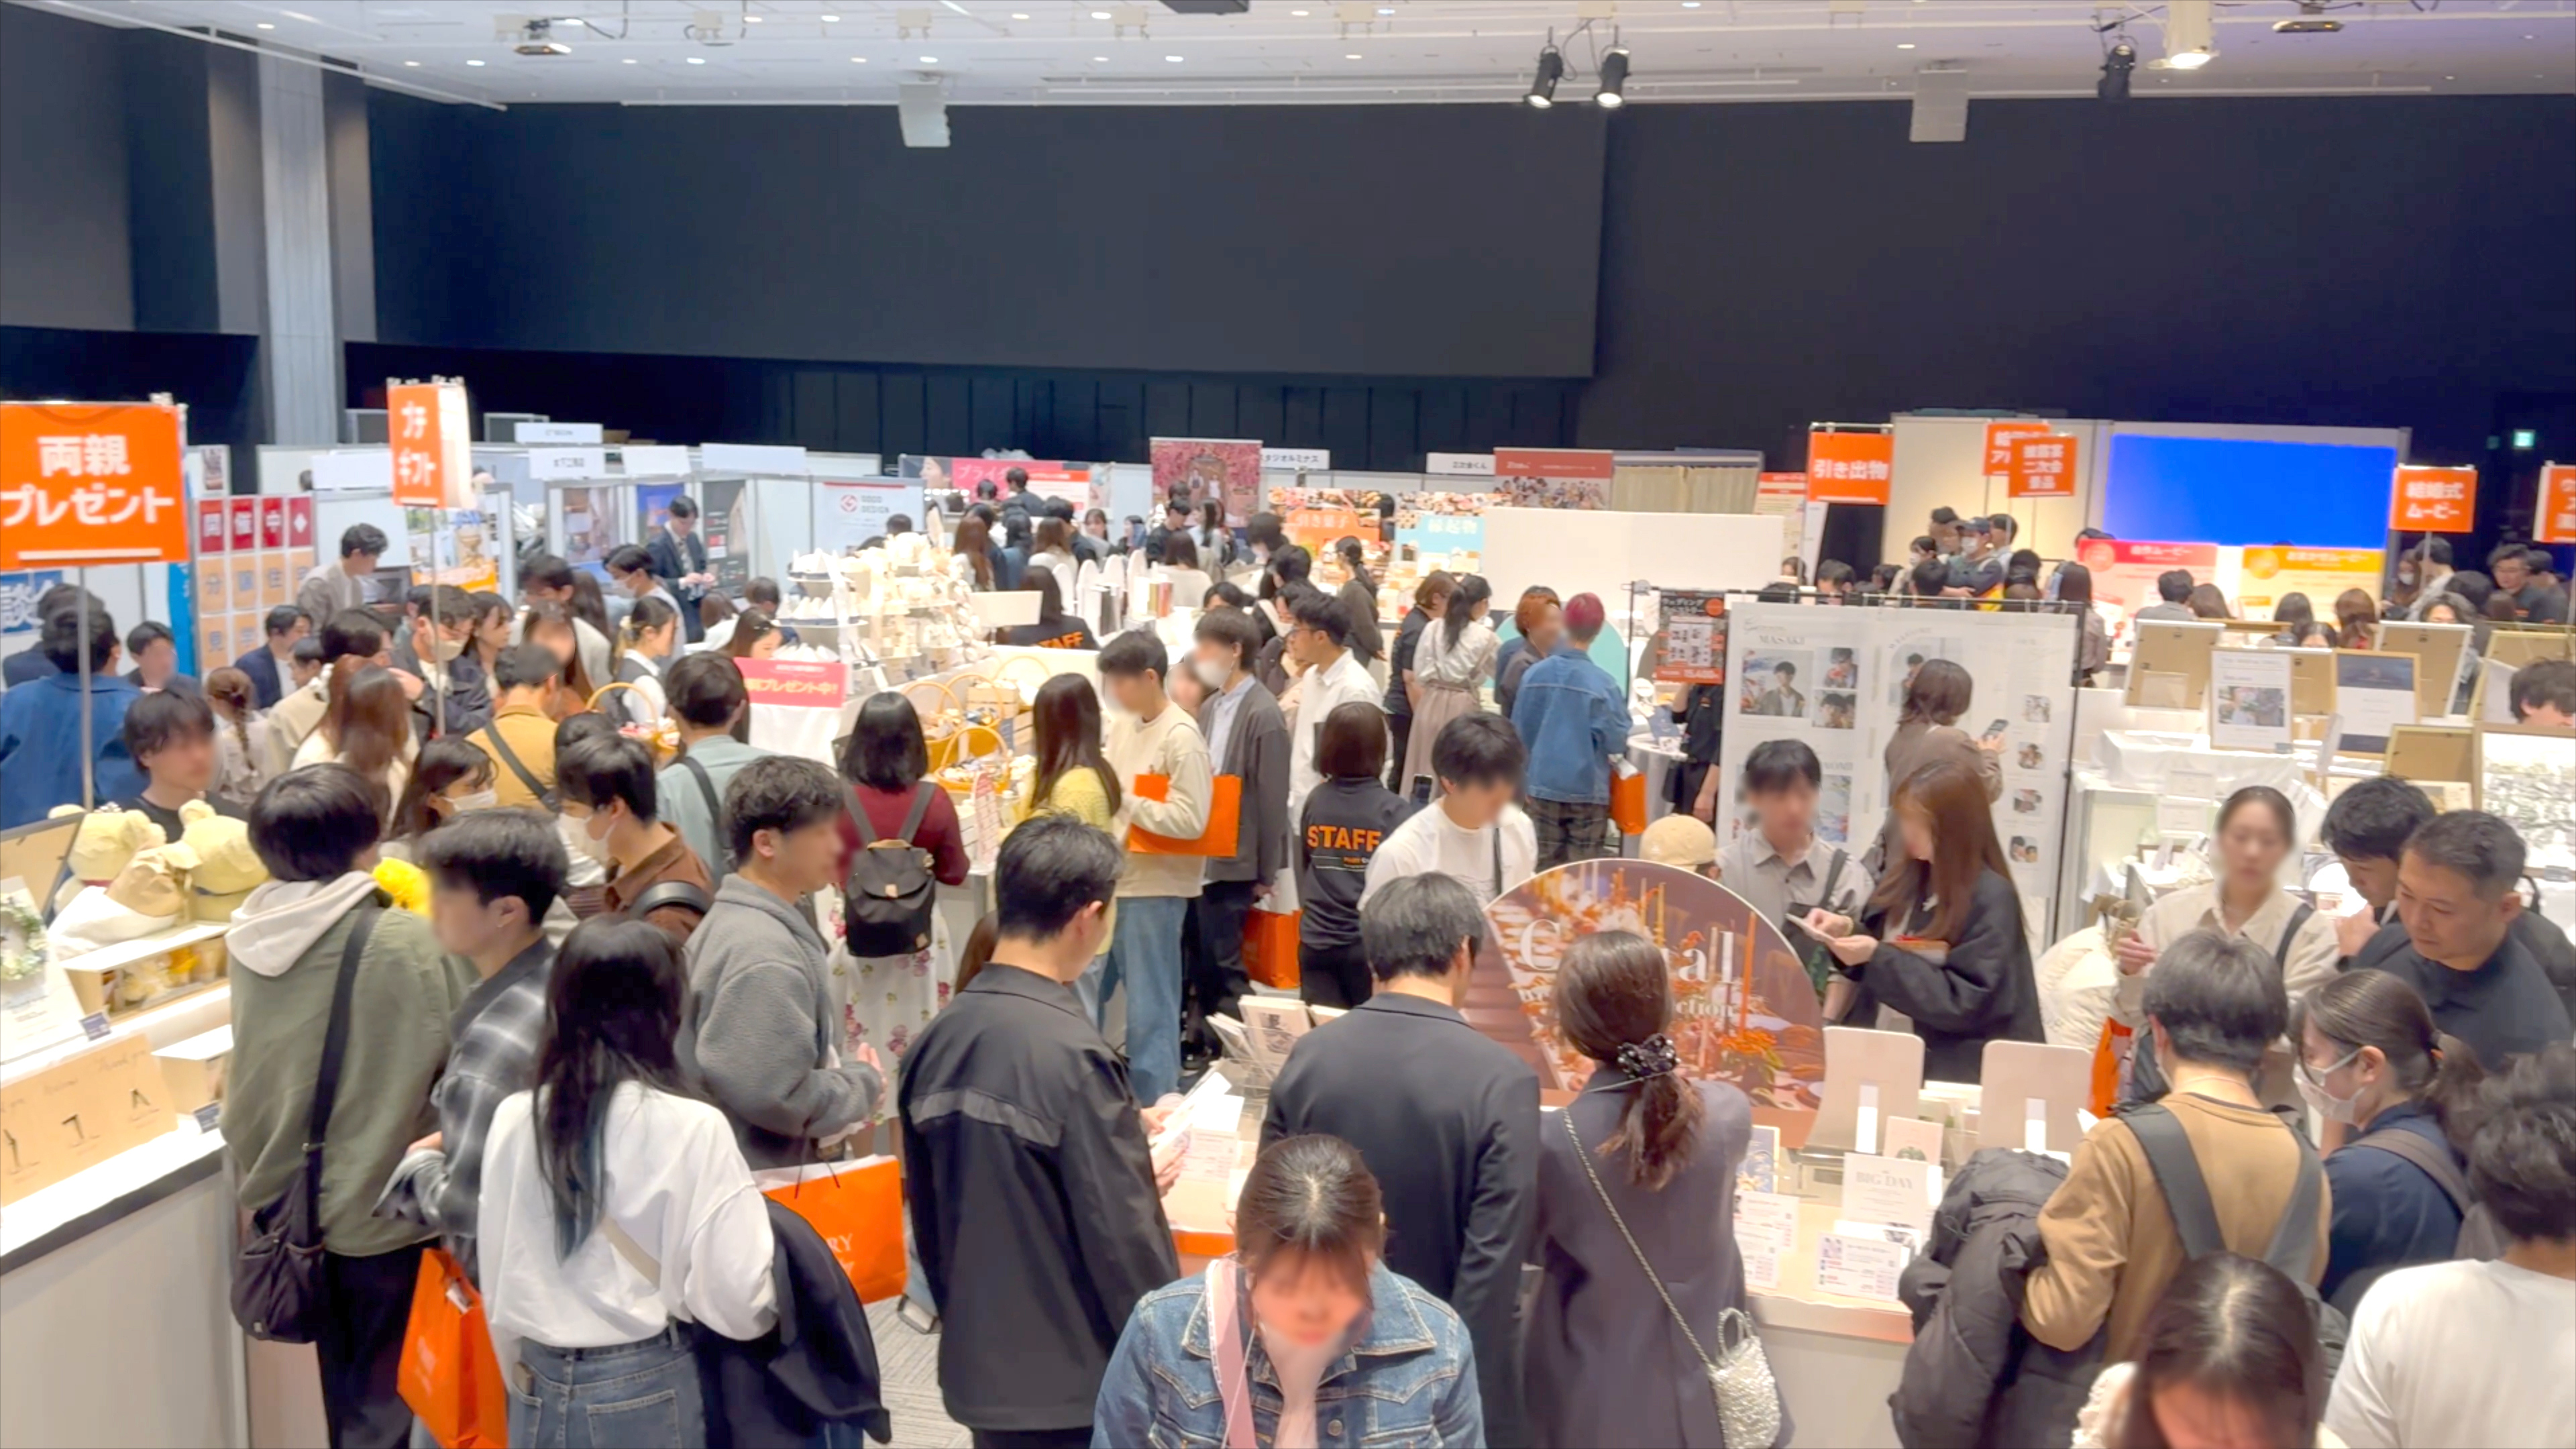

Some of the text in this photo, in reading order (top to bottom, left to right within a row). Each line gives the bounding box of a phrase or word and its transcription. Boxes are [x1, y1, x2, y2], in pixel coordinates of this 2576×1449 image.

[38, 434, 131, 477] 両親
[1261, 453, 1318, 463] タジオルミナス
[1813, 459, 1888, 480] 引き出物
[2023, 460, 2063, 474] 二次会
[2406, 482, 2464, 499] 結婚式
[0, 482, 175, 526] プレゼント
[2406, 502, 2460, 519] ムービー
[1307, 825, 1381, 851] STAFF
